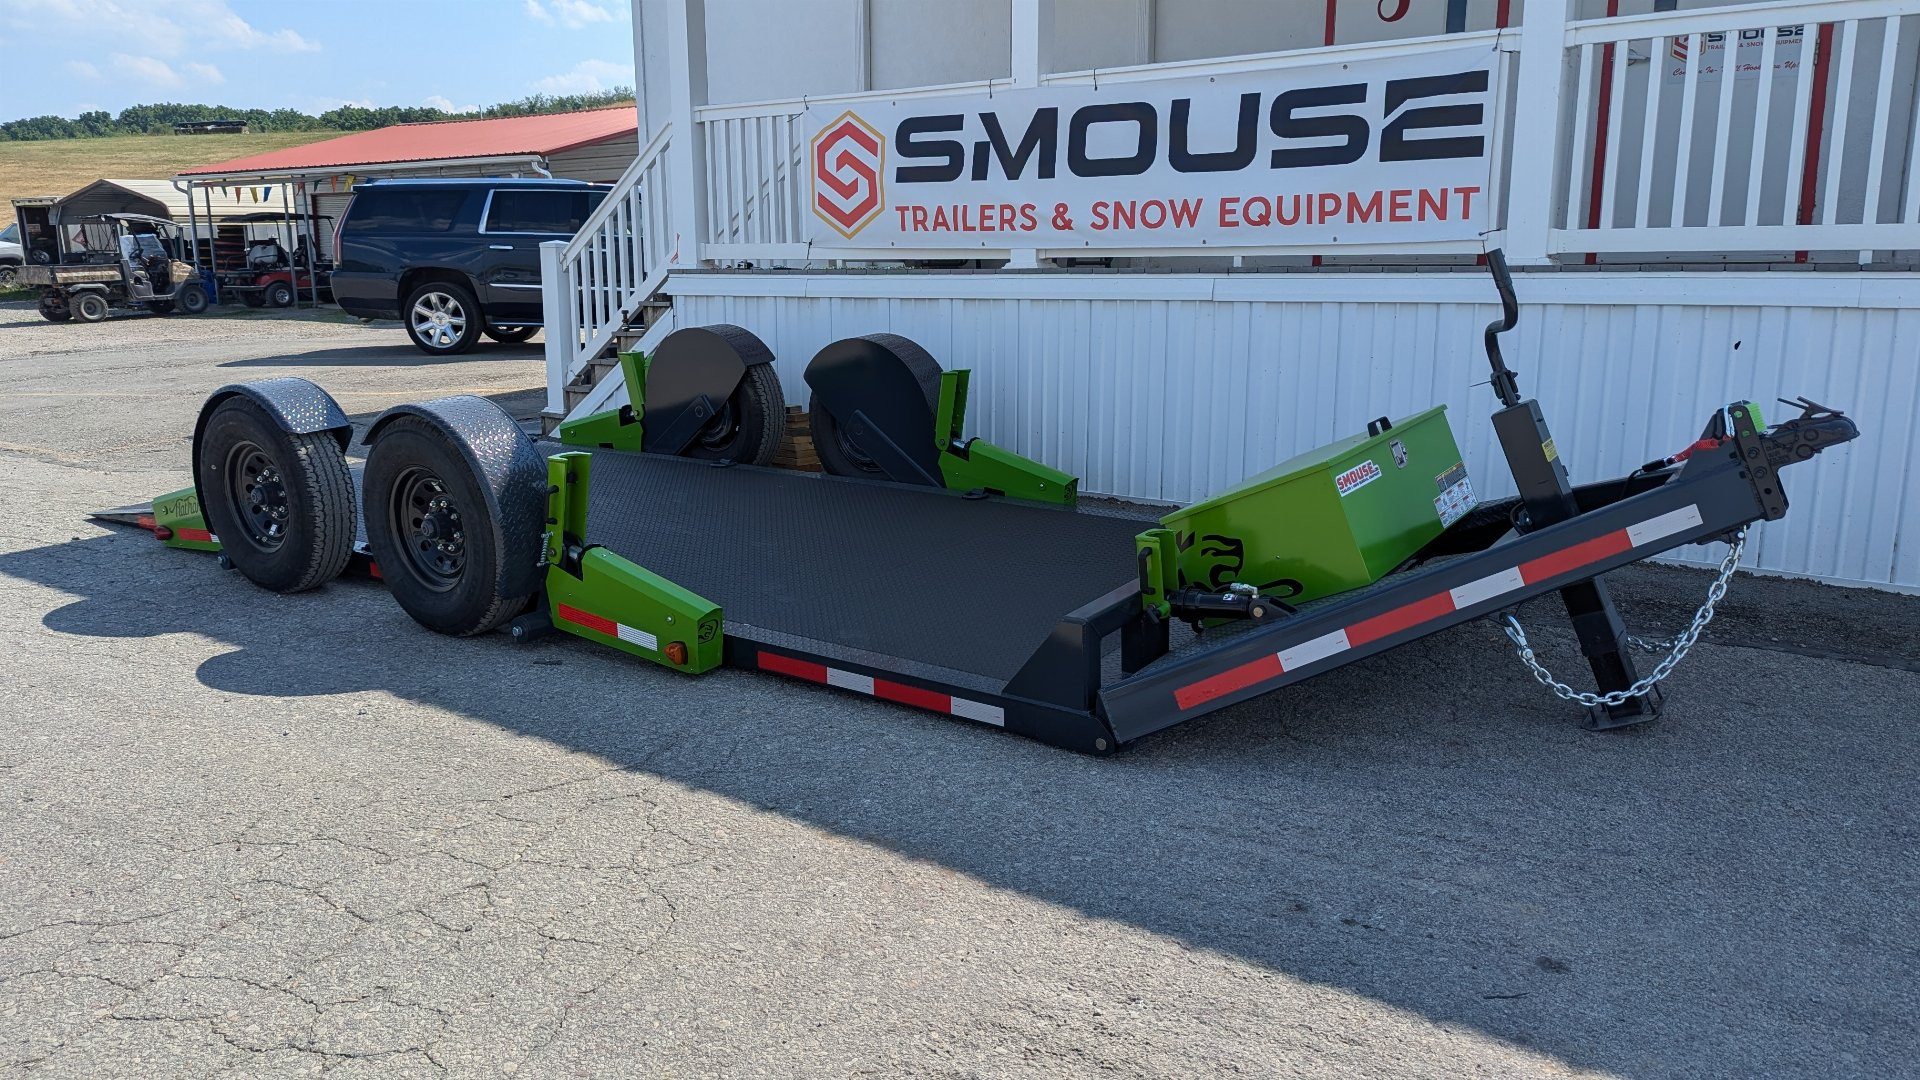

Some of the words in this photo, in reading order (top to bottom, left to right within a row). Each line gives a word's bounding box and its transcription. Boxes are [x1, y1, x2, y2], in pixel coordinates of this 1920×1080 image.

[895, 70, 1489, 183] SMOUSE
[895, 203, 1037, 232] TRAILERS
[1052, 202, 1074, 231] &
[1090, 198, 1203, 230] SNOW
[1219, 186, 1481, 229] EQUIPMENT
[1336, 461, 1373, 491] SMOUSE
